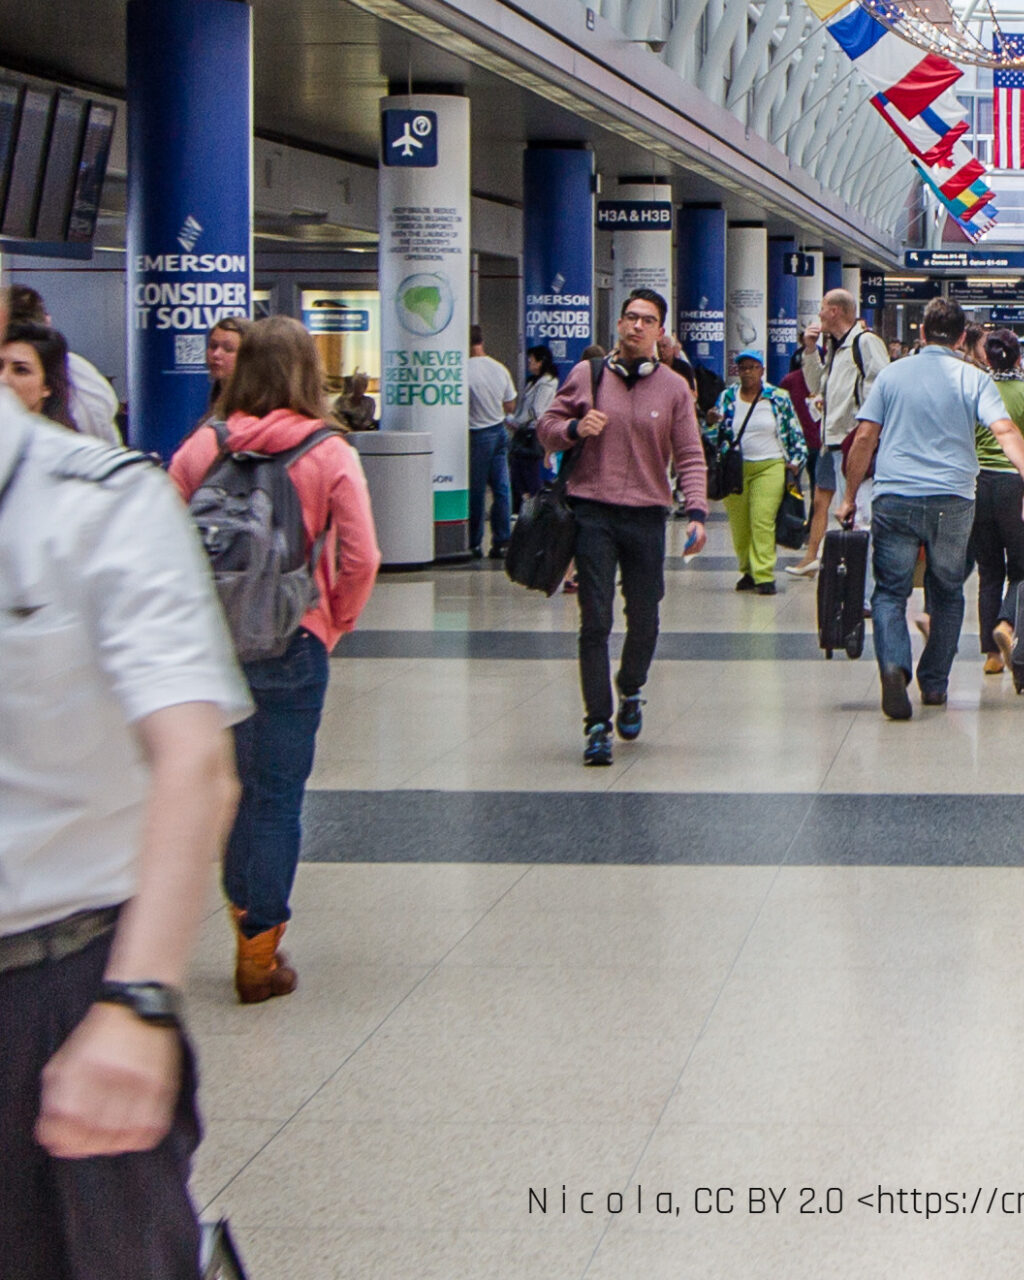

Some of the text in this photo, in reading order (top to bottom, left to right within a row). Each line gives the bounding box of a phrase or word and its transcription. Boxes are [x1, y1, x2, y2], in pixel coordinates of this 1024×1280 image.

[598, 210, 670, 222] H3A & H3B
[134, 254, 246, 272] EMERSON
[134, 283, 247, 306] CONSIDER
[526, 294, 590, 306] EMERSON
[867, 295, 877, 305] G
[135, 307, 151, 330] IT
[526, 311, 590, 325] CONSIDER
[680, 310, 724, 319] EMERSON
[526, 324, 590, 338] IT SOLVED
[680, 322, 724, 332] CONSIDER
[690, 331, 724, 341] SOLVED
[384, 350, 463, 366] IT'S NEVER
[385, 368, 463, 382] BEEN DONE
[385, 384, 463, 406] BEFORE
